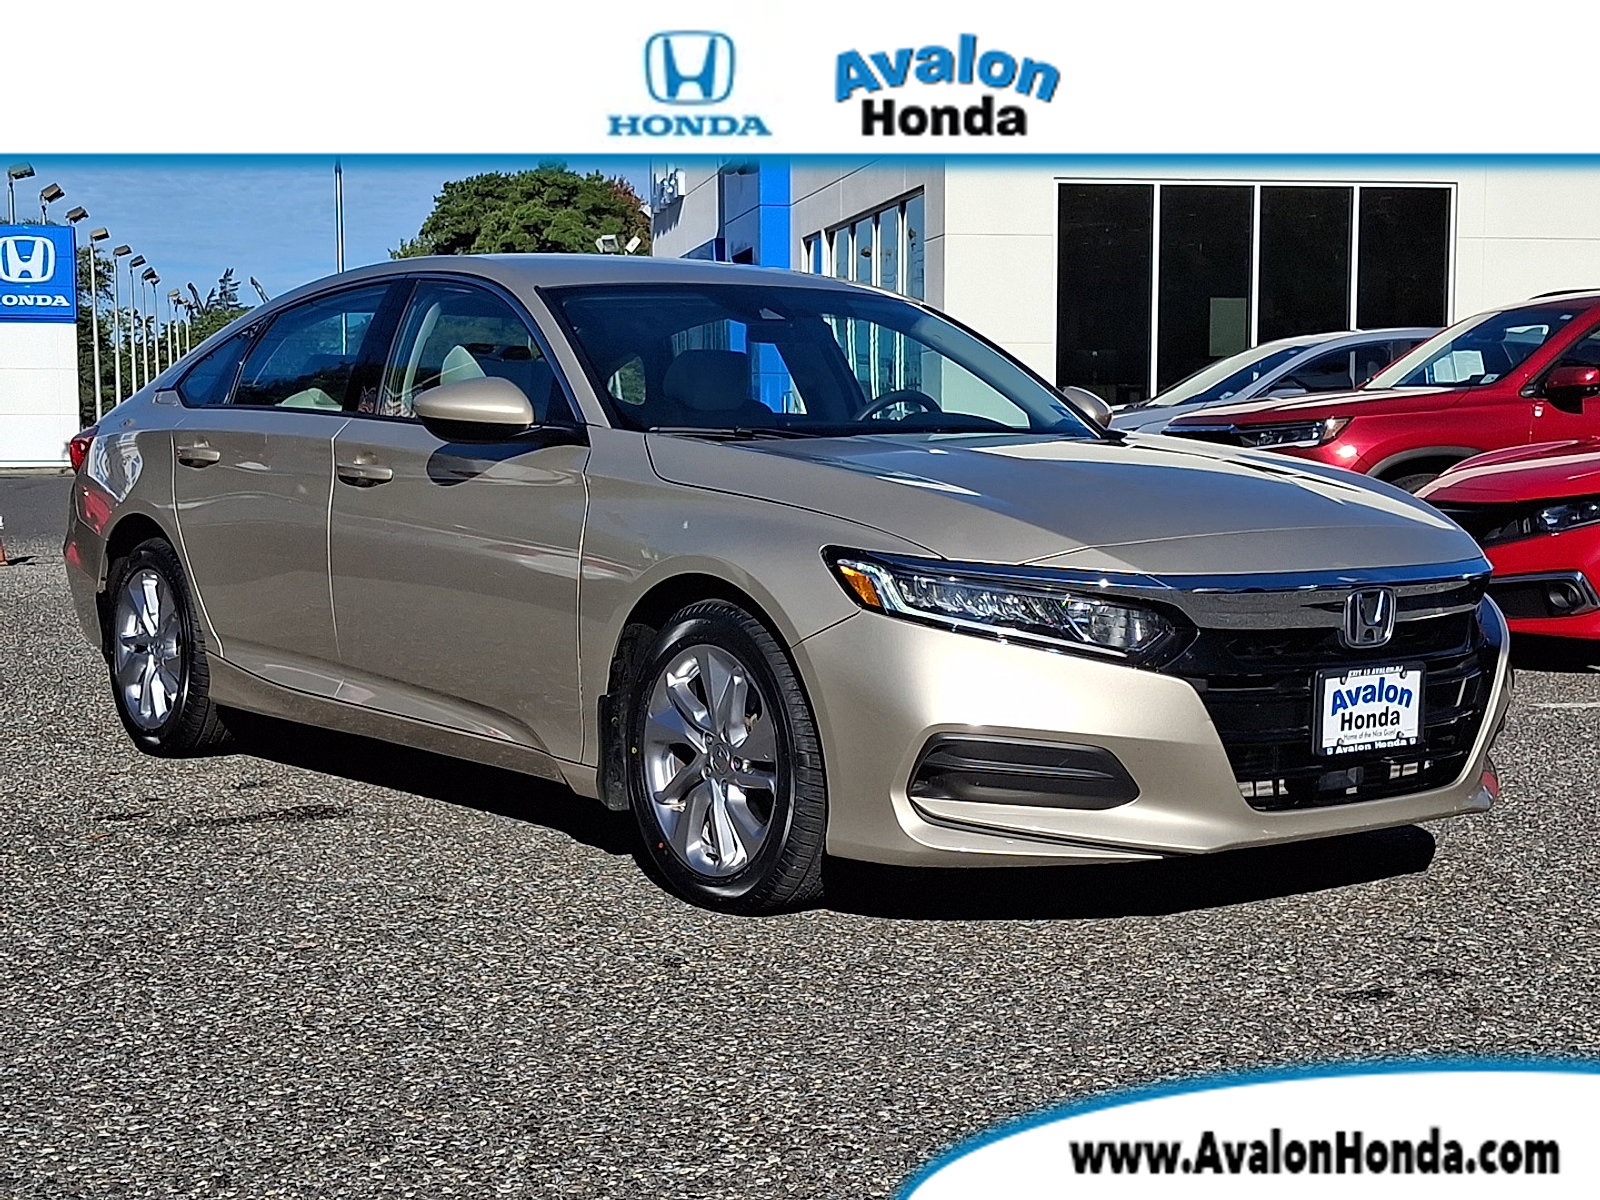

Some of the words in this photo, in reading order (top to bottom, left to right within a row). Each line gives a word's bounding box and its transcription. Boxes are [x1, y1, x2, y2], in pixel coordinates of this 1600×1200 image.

[0, 295, 70, 307] ONDA
[1331, 677, 1413, 716] Avalon
[1340, 706, 1400, 731] Honda
[1335, 744, 1371, 754] Avalon
[1374, 738, 1407, 749] Honda
